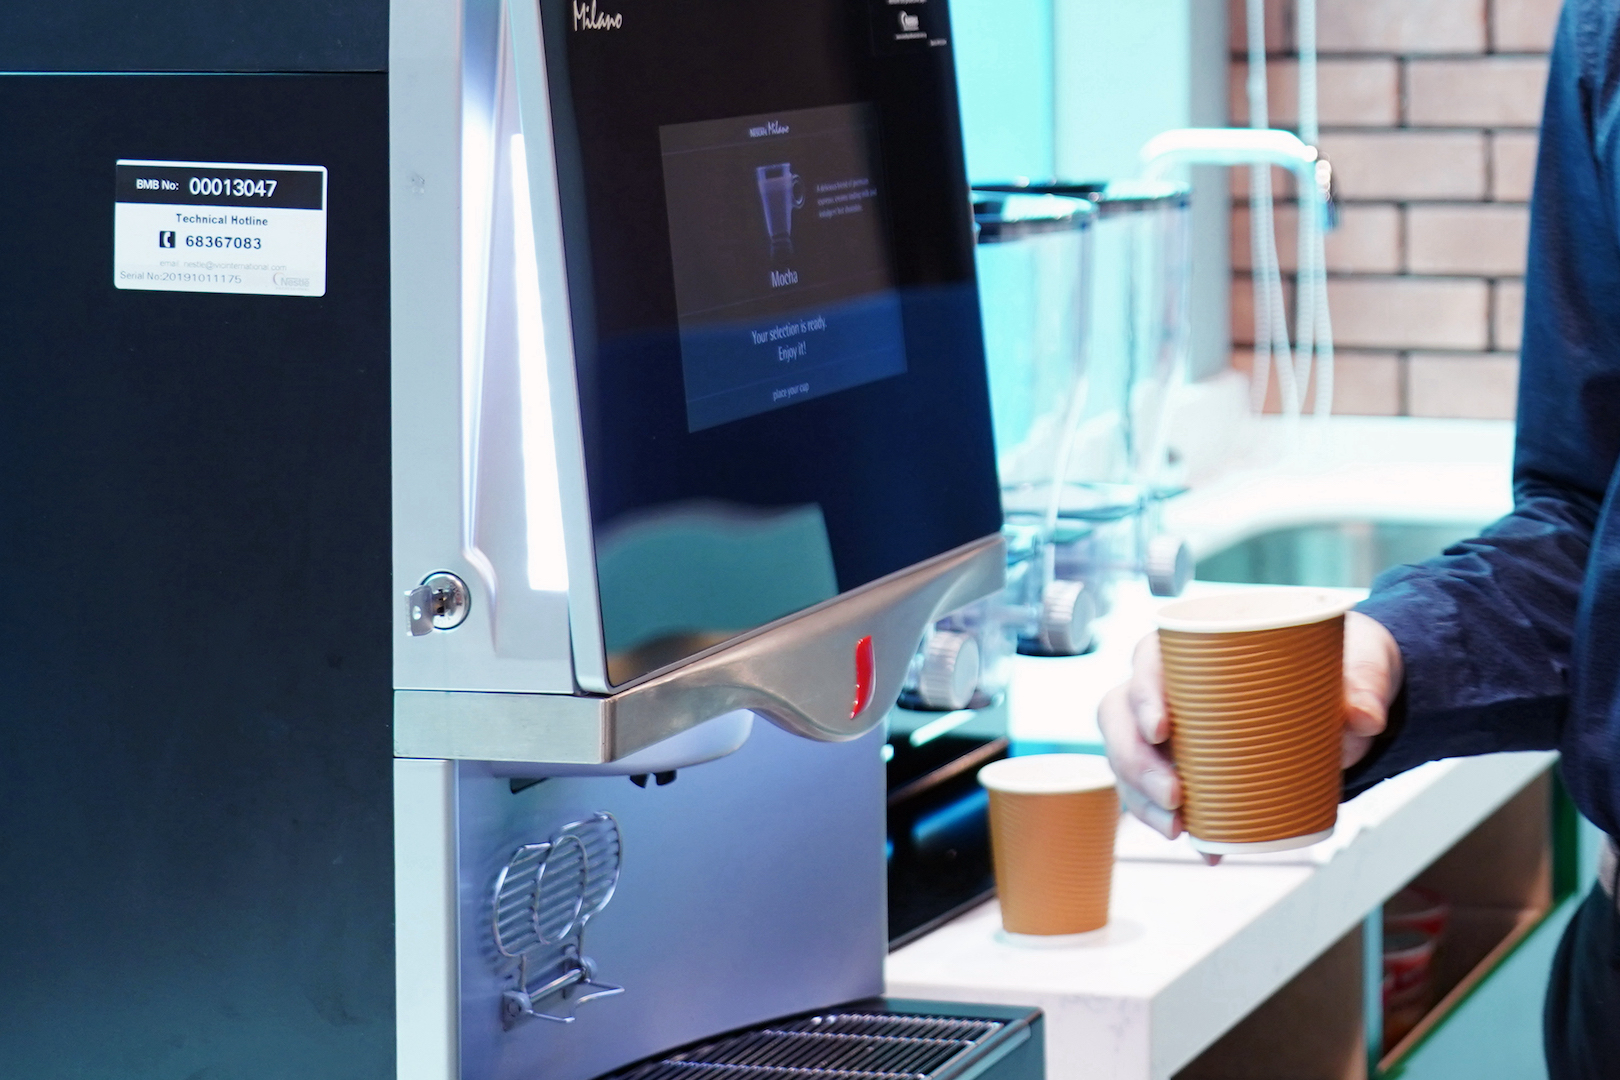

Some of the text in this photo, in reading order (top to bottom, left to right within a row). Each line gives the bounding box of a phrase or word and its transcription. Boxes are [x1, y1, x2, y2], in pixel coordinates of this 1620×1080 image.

[136, 176, 278, 198] BMB No: 00013047
[175, 213, 269, 227] Technical Hotline
[185, 235, 262, 250] 68367083
[119, 270, 145, 281] Serial
[770, 268, 799, 288] Mocha
[751, 315, 828, 345] Your selection is ready.
[778, 340, 807, 363] Enjoy it!
[772, 382, 810, 402] place your cup
